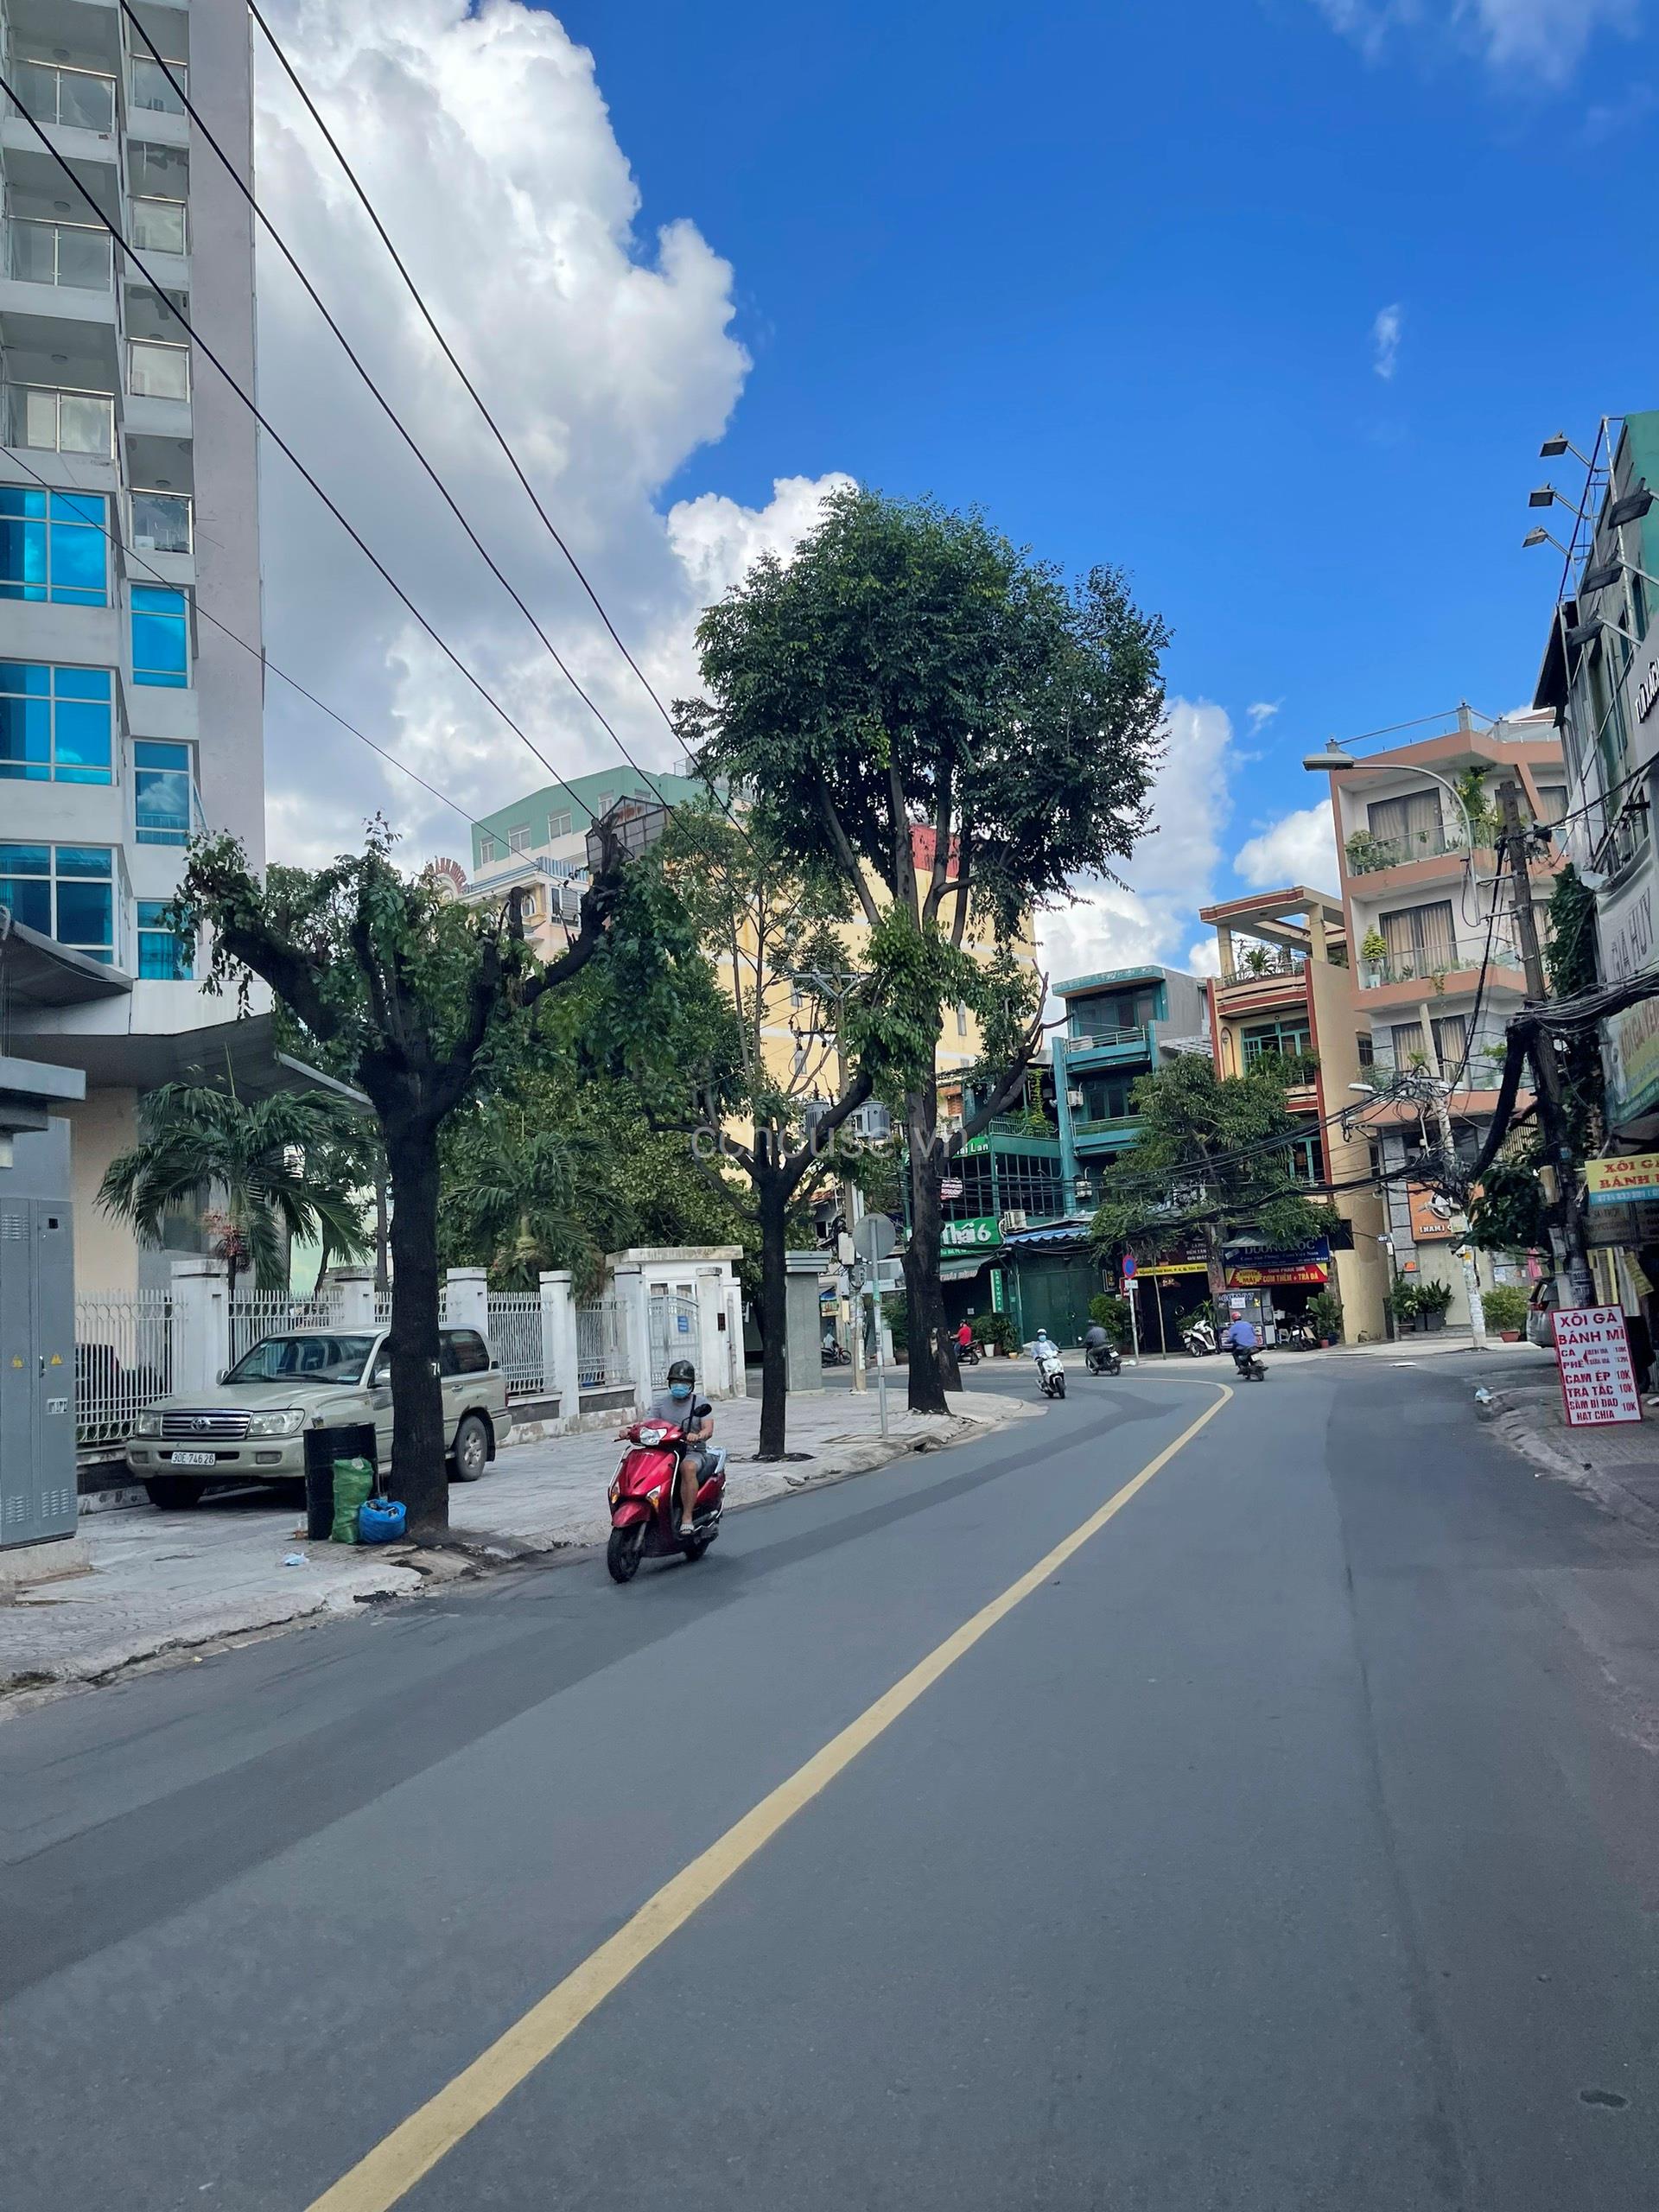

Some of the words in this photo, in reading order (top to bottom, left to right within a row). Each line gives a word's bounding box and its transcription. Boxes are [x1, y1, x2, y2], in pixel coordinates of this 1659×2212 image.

[1629, 887, 1654, 967] HUY
[1604, 1160, 1636, 1173] XÔI
[1599, 1175, 1650, 1189] BÁNH
[977, 1224, 991, 1242] 6
[1560, 1313, 1588, 1328] XÔI
[1593, 1309, 1618, 1324] GÀ
[1558, 1331, 1601, 1345] BÁNH
[1606, 1325, 1625, 1341] MÌ
[1566, 1372, 1592, 1384] CAM
[1596, 1370, 1611, 1382] ÉP
[1617, 1370, 1631, 1380] 10K
[1619, 1383, 1634, 1393] 10K
[1623, 1402, 1637, 1411] 10K
[1594, 1410, 1615, 1420] CHIA
